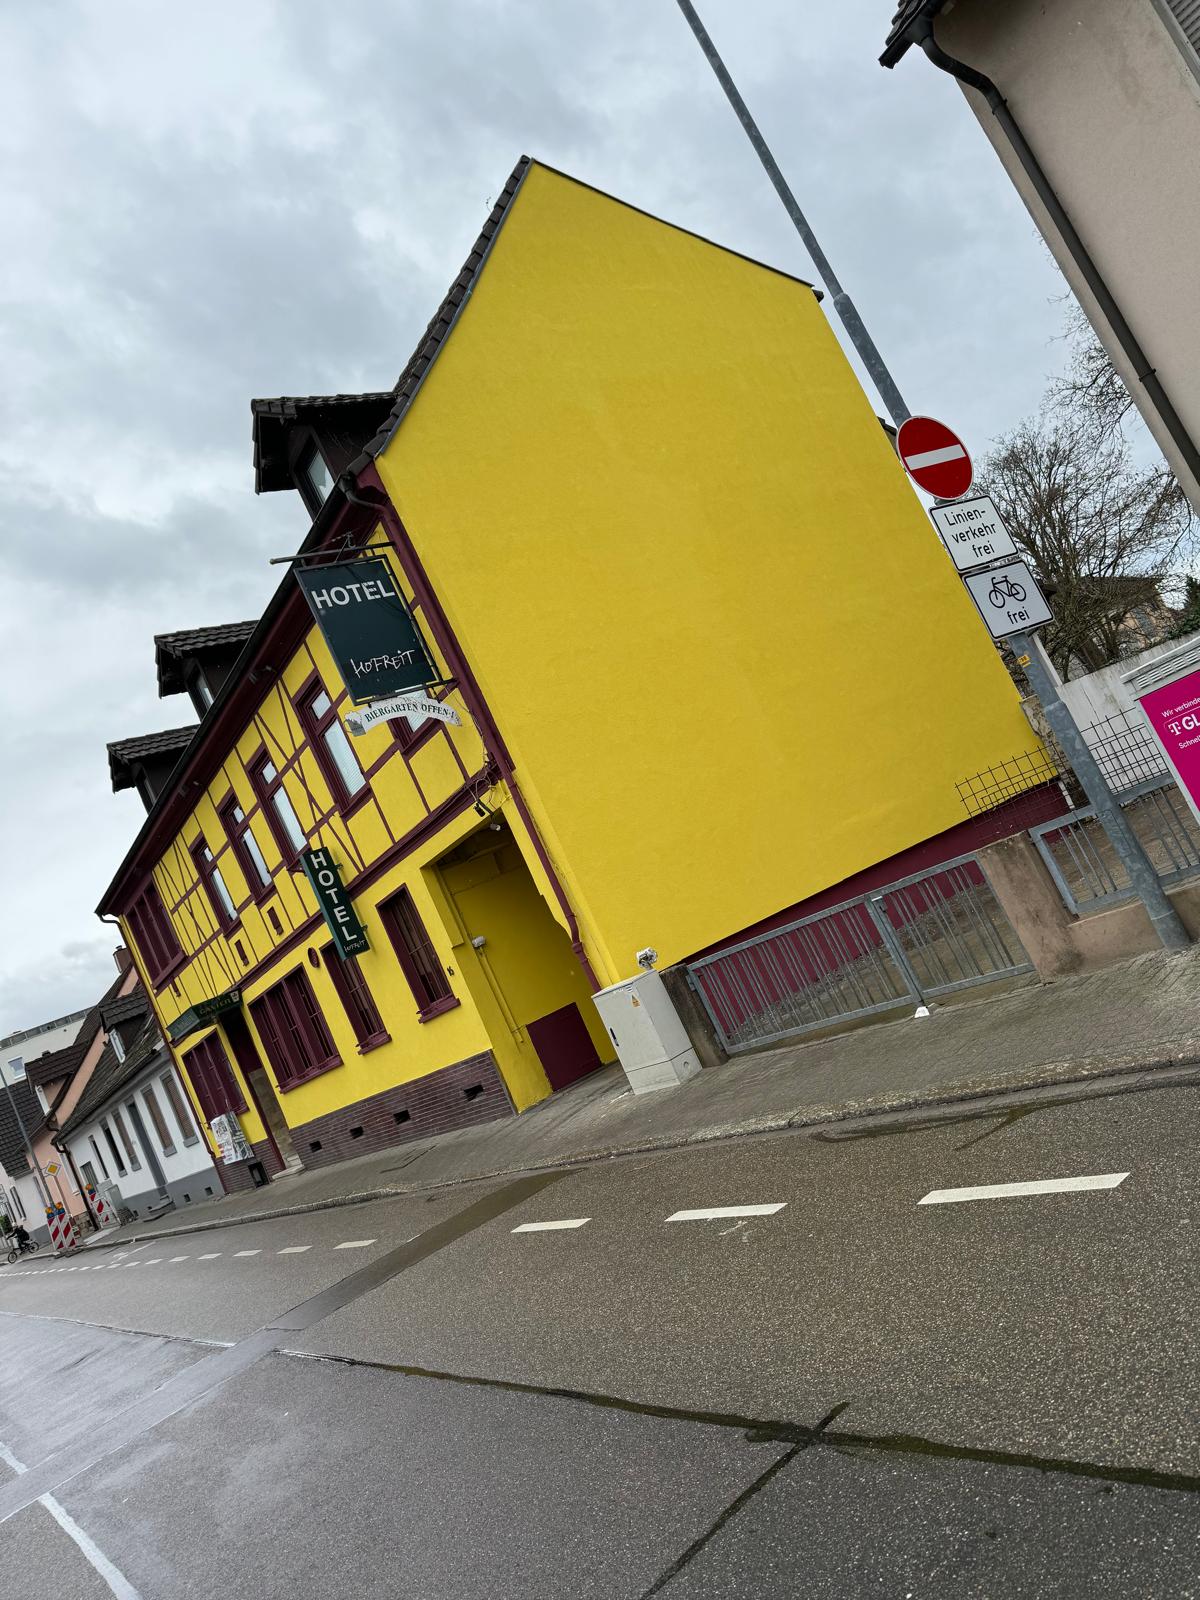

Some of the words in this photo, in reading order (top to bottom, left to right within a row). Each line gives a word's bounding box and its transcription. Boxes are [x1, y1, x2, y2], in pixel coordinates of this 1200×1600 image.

[944, 508, 986, 526] Linien-
[952, 522, 996, 543] verkehr
[972, 540, 995, 557] frei
[311, 580, 396, 609] HOTEL
[1007, 606, 1030, 624] frei
[364, 702, 418, 722] BIERGARTEN
[1162, 709, 1174, 718] Wir
[310, 851, 357, 941] HOTEL
